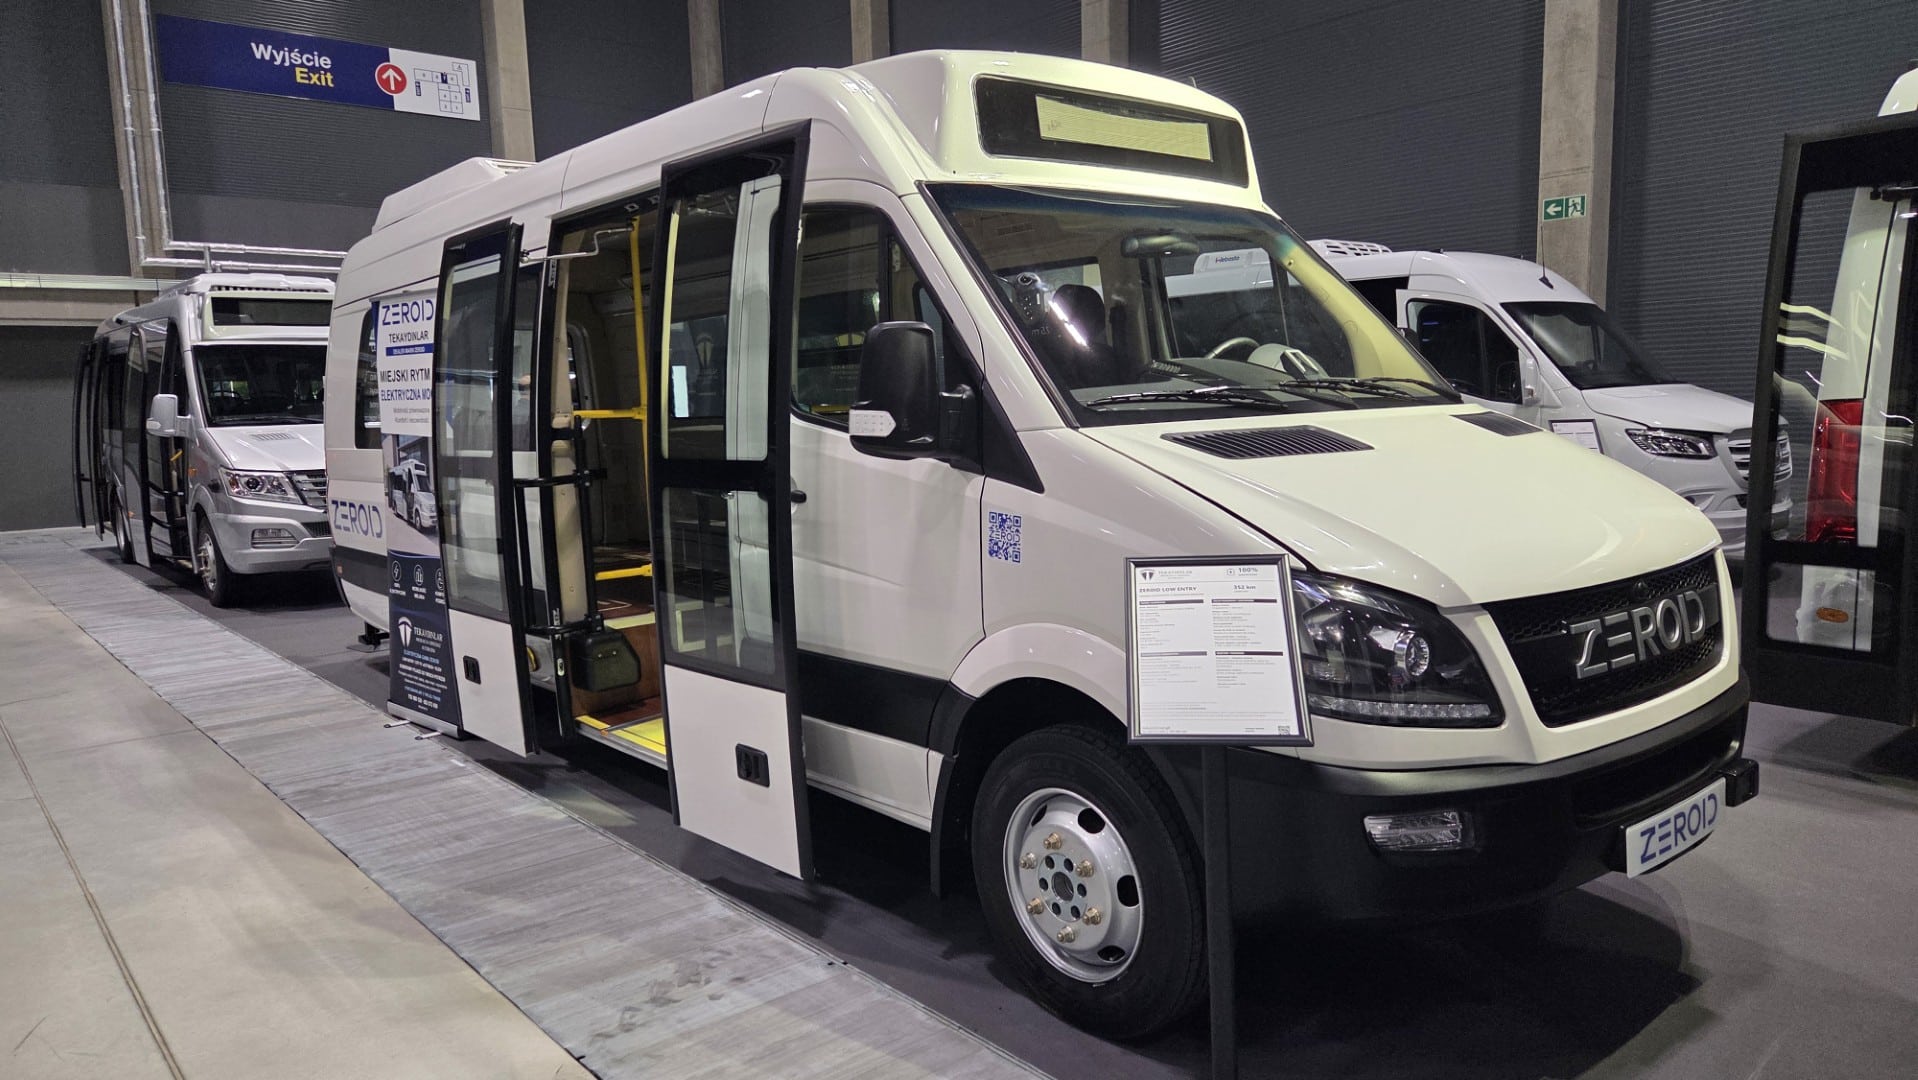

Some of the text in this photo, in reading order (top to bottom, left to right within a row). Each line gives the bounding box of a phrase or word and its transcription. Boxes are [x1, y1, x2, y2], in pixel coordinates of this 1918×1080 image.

[250, 42, 332, 69] Wyjście
[295, 66, 335, 88] Exit
[381, 299, 434, 325] ZEROID
[389, 331, 429, 343] TEKAYDINLAR
[379, 367, 430, 383] MIEJSKI RYTM
[380, 388, 421, 401] ELEKTRYCZNA
[331, 499, 383, 539] ZEROID
[988, 529, 1021, 543] ZEROID
[1569, 590, 1706, 680] ZEROID
[1640, 792, 1719, 864] ZEROID
